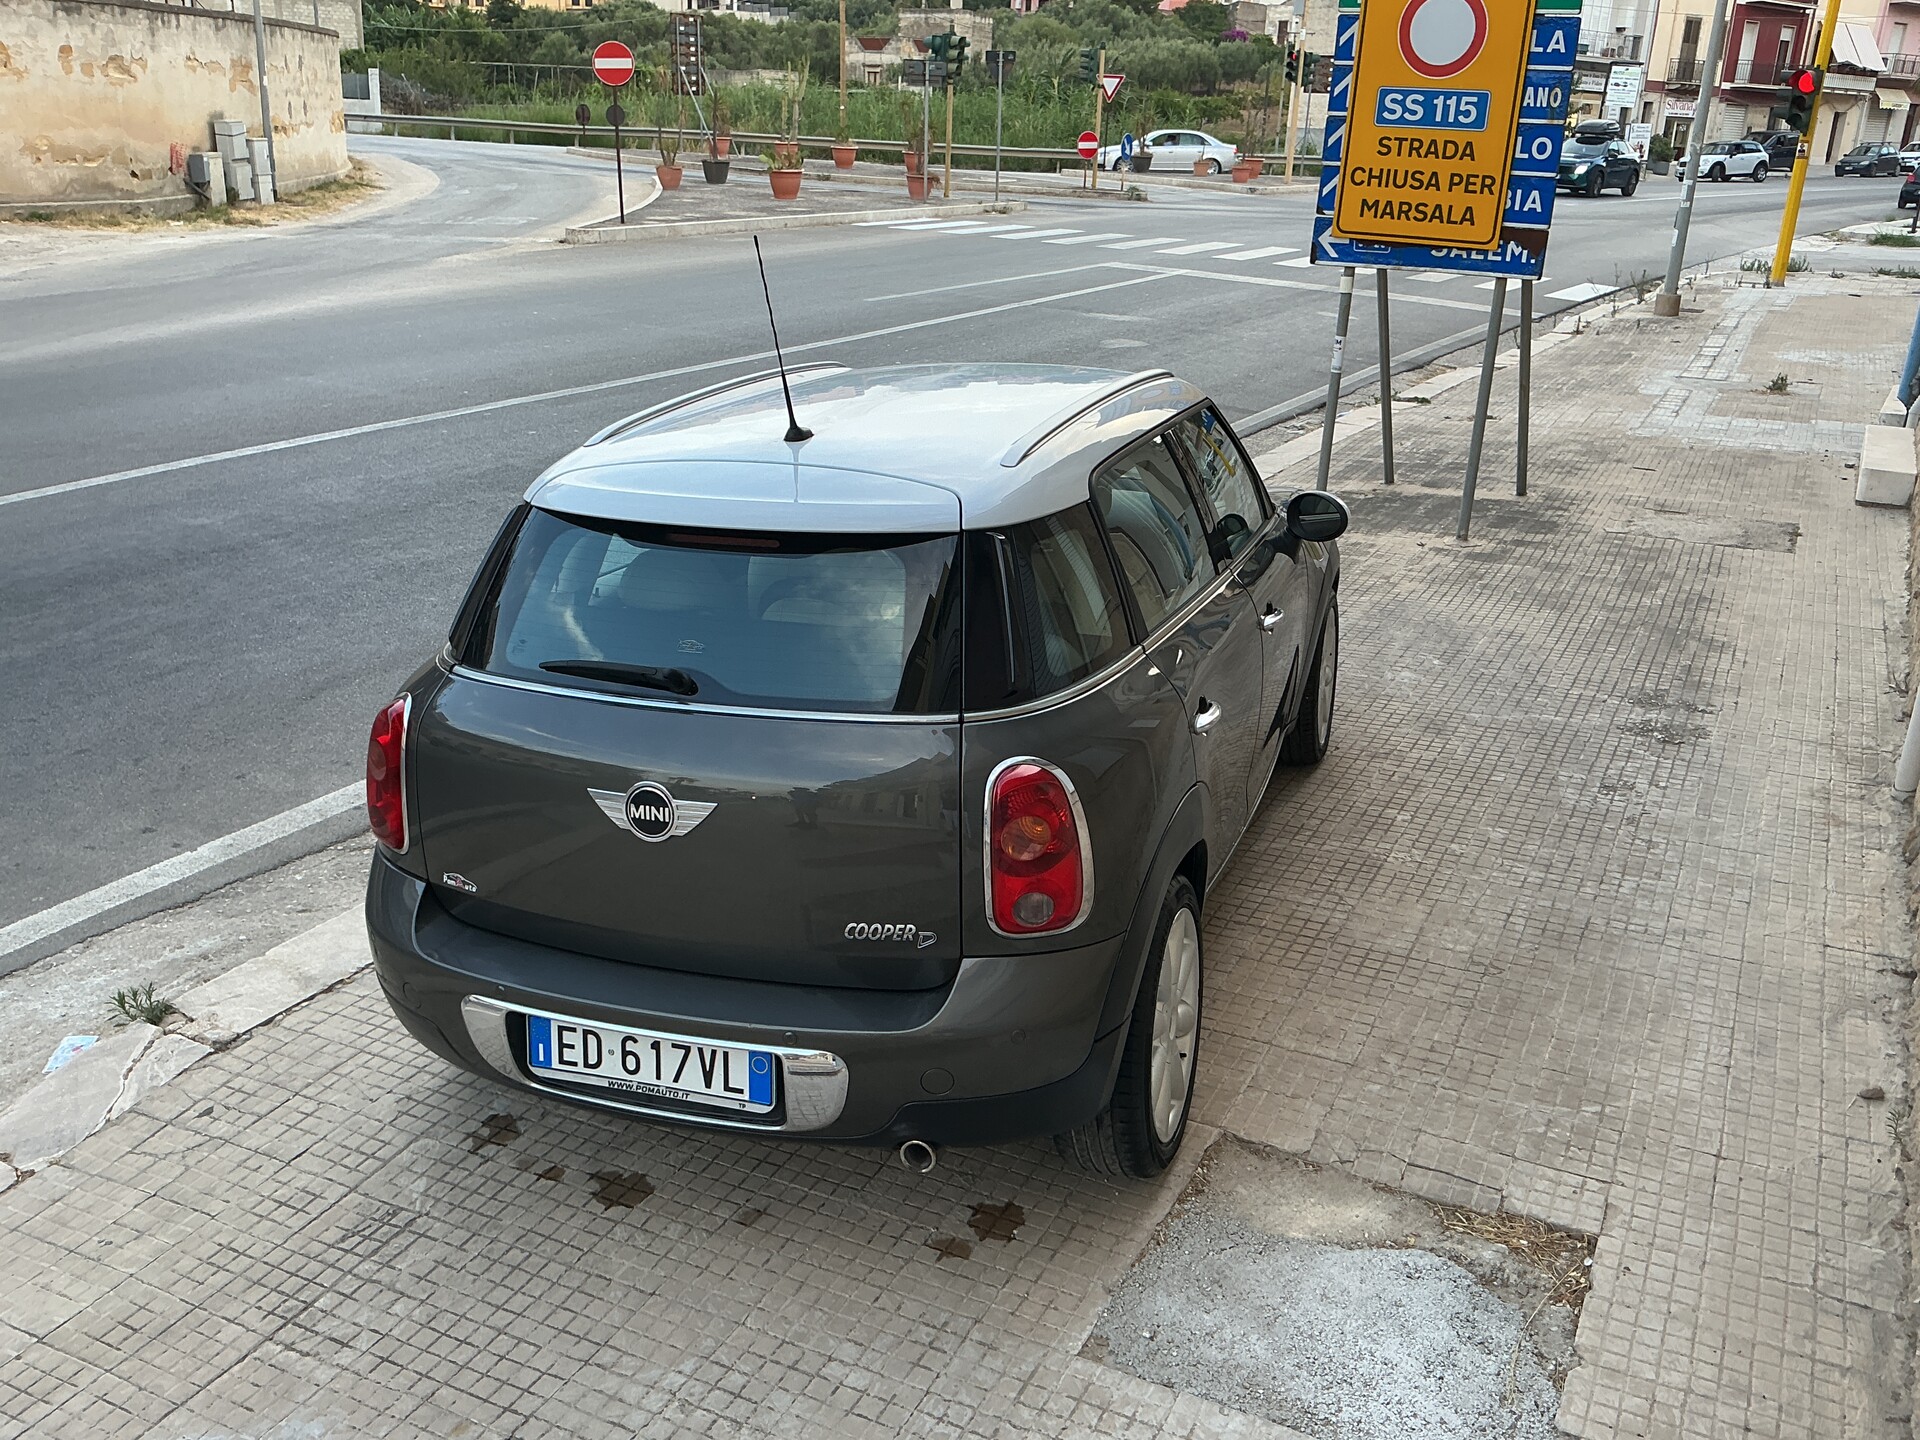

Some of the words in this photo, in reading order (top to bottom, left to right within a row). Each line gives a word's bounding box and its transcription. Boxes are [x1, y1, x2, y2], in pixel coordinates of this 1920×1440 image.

[1382, 93, 1425, 121] SS
[1433, 95, 1478, 124] 115
[1523, 86, 1562, 108] ANO
[1376, 136, 1475, 161] STRADA
[1514, 136, 1552, 160] LO
[1350, 166, 1441, 192] CHIUSA
[1448, 172, 1496, 195] PER
[1359, 198, 1475, 226] MARSALA
[630, 803, 670, 823] MINI
[844, 922, 917, 941] COOPER
[557, 1025, 603, 1070] ED
[620, 1035, 745, 1095] 617VL
[607, 1080, 690, 1100] WWW.POMAUTO.IT
